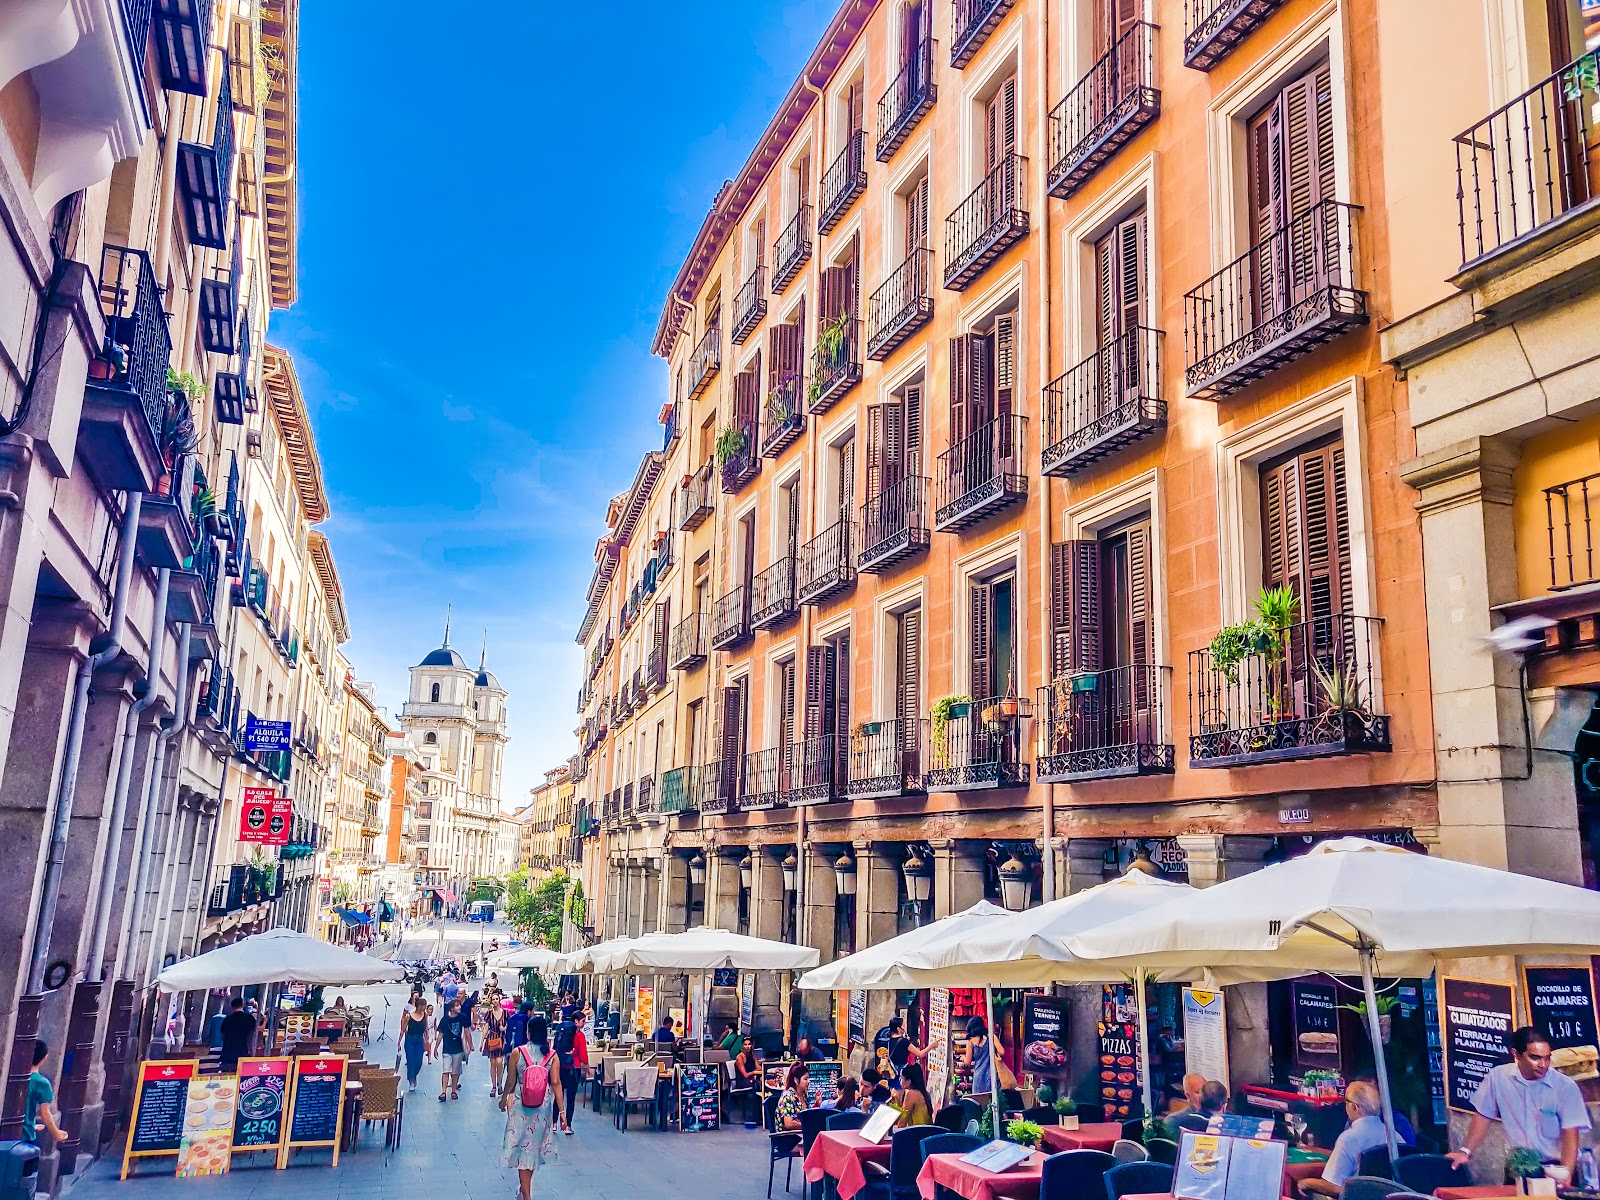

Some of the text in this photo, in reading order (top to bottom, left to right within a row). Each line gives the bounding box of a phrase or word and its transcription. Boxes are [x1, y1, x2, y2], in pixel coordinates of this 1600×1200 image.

[253, 728, 284, 737] ALQUILA
[248, 734, 256, 742] 91
[256, 735, 270, 743] 540
[1278, 808, 1310, 821] TOLEDO
[1161, 841, 1185, 851] MAD
[1536, 985, 1582, 993] BOCADILLO DE
[1299, 999, 1334, 1009] CALAMARES
[1534, 995, 1590, 1006] CALAMARES
[1034, 1012, 1061, 1020] TERNERA
[1450, 1011, 1507, 1032] CLIMATIZADOS
[1458, 1028, 1493, 1043] TERRAZA
[1101, 1037, 1131, 1055] PIZZAS
[1454, 1037, 1509, 1055] PLANTA BAJA
